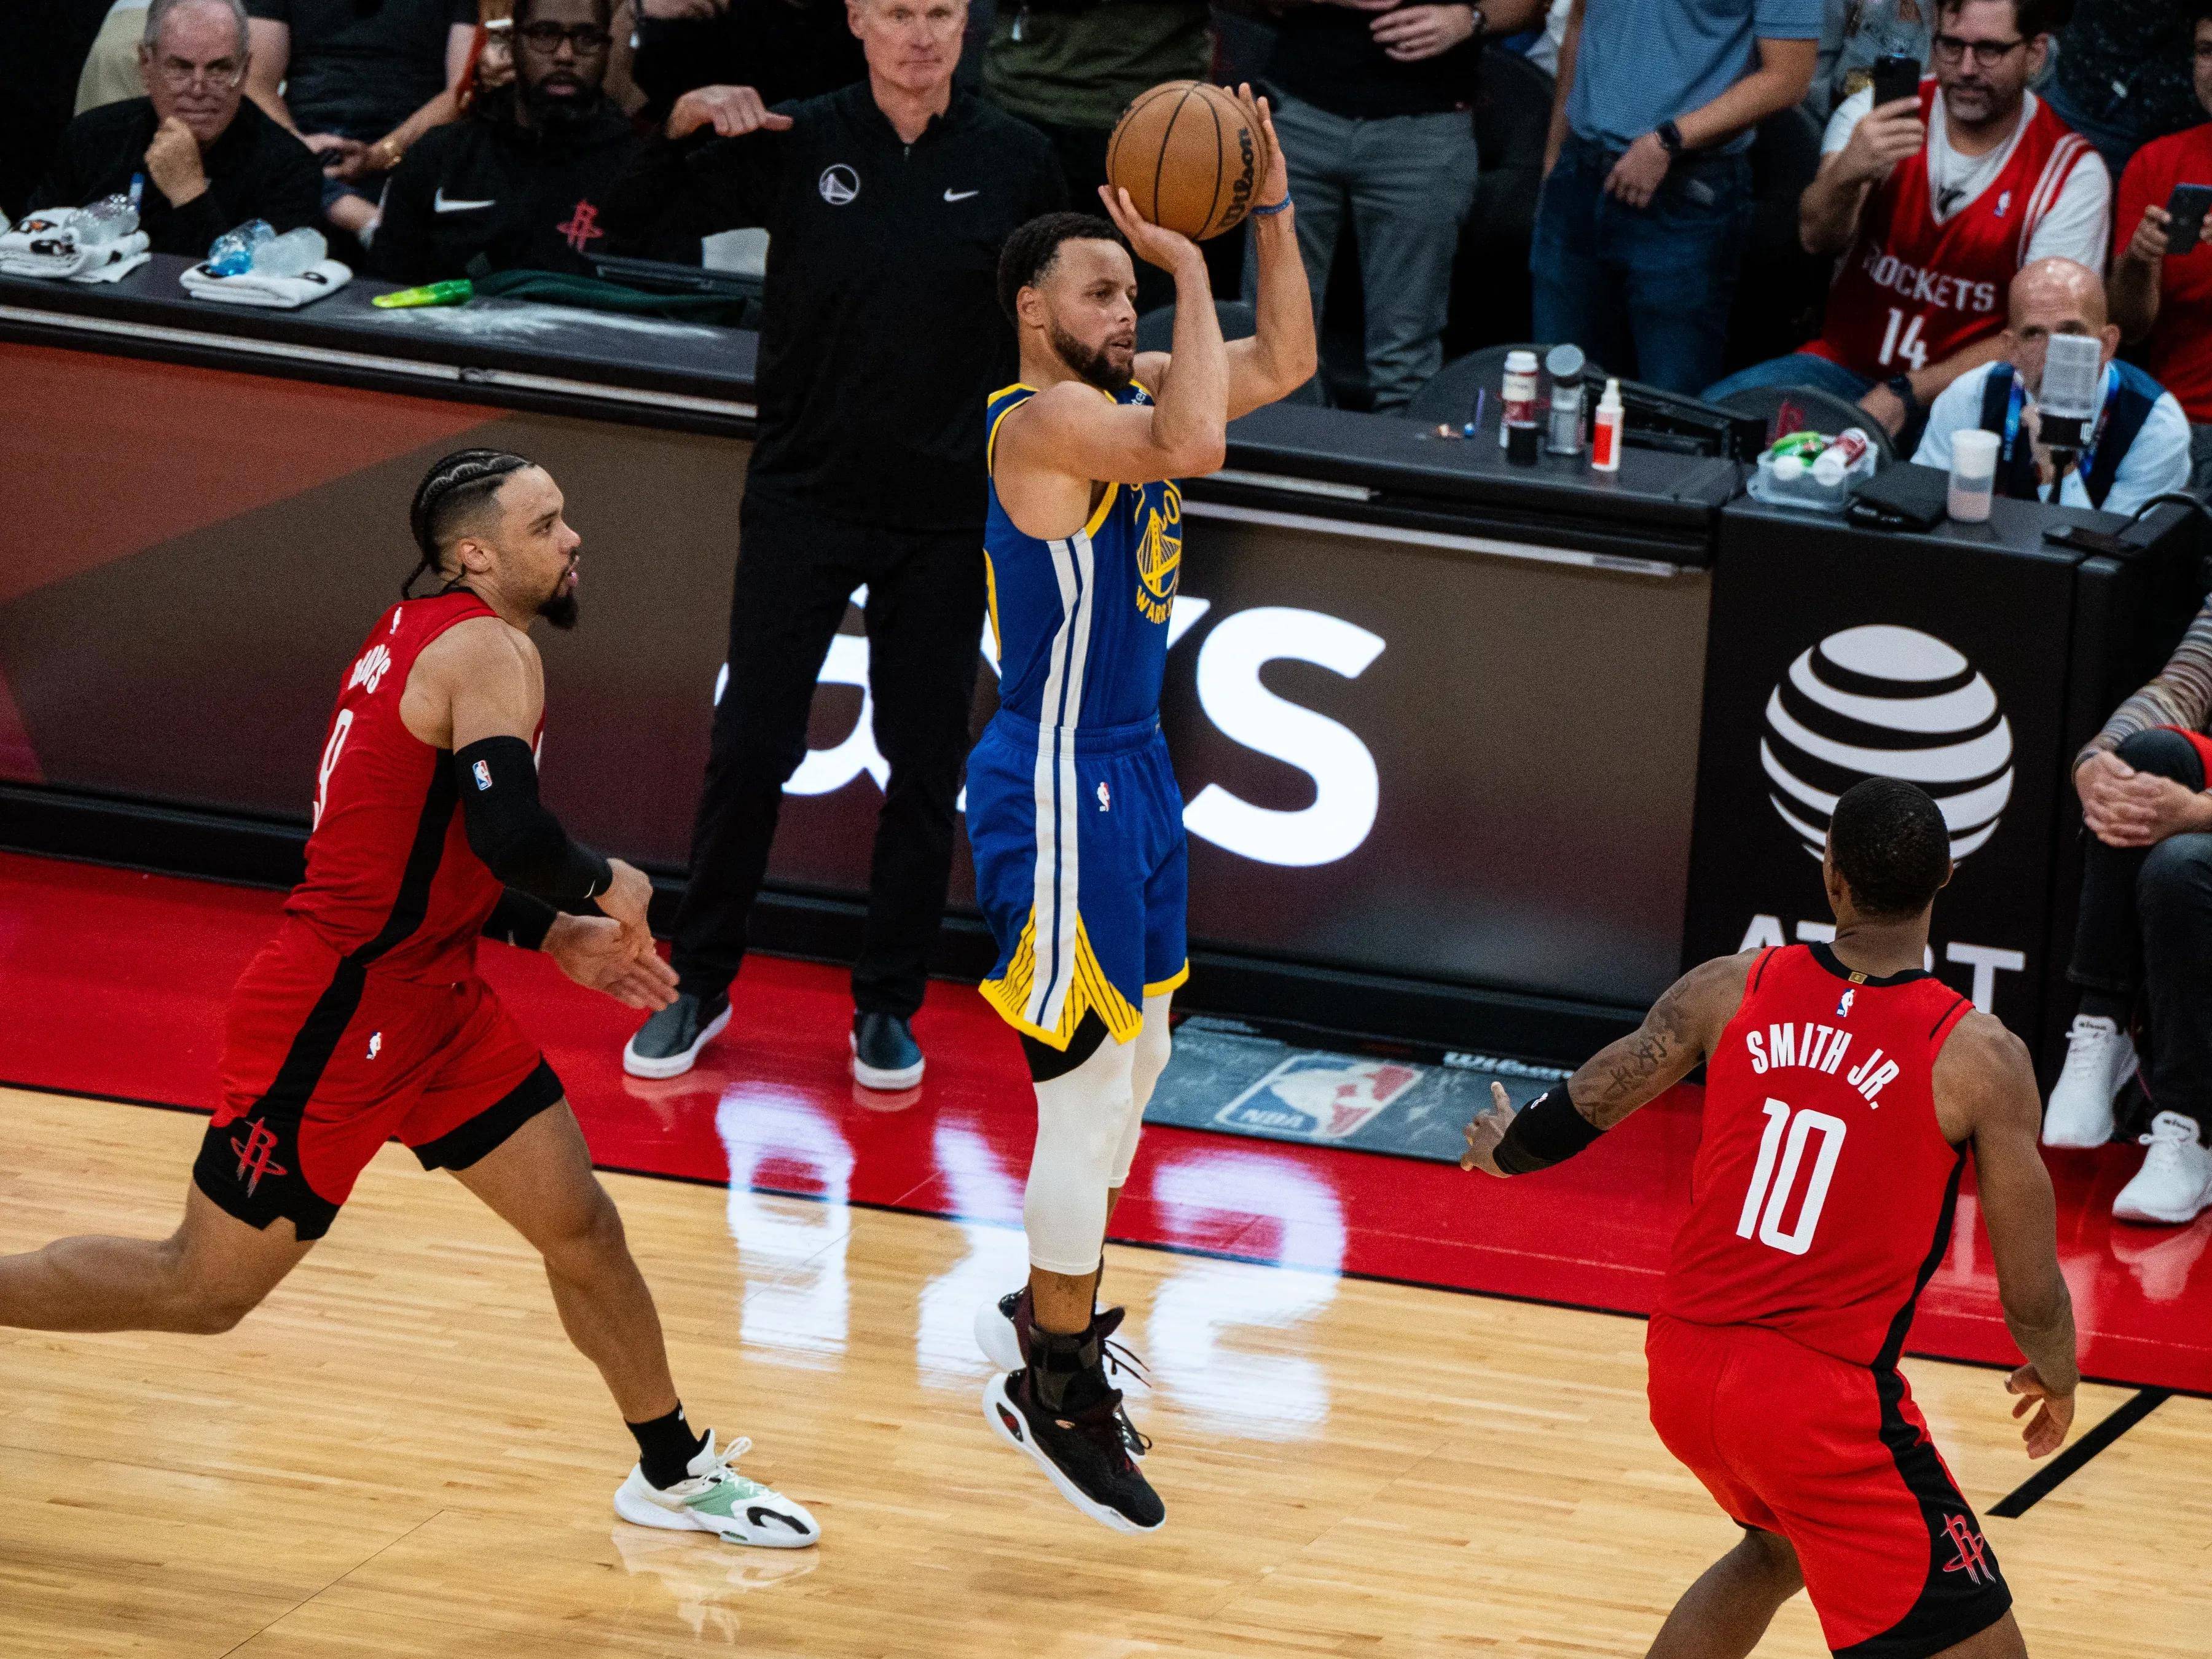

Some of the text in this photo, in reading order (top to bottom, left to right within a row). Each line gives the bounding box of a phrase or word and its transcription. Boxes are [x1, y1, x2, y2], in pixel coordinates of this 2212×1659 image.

[1217, 128, 1255, 229] Wilson
[1877, 305, 1929, 371] 14
[1746, 1022, 1900, 1110] SMITH JR.
[1736, 1097, 1847, 1255] 10
